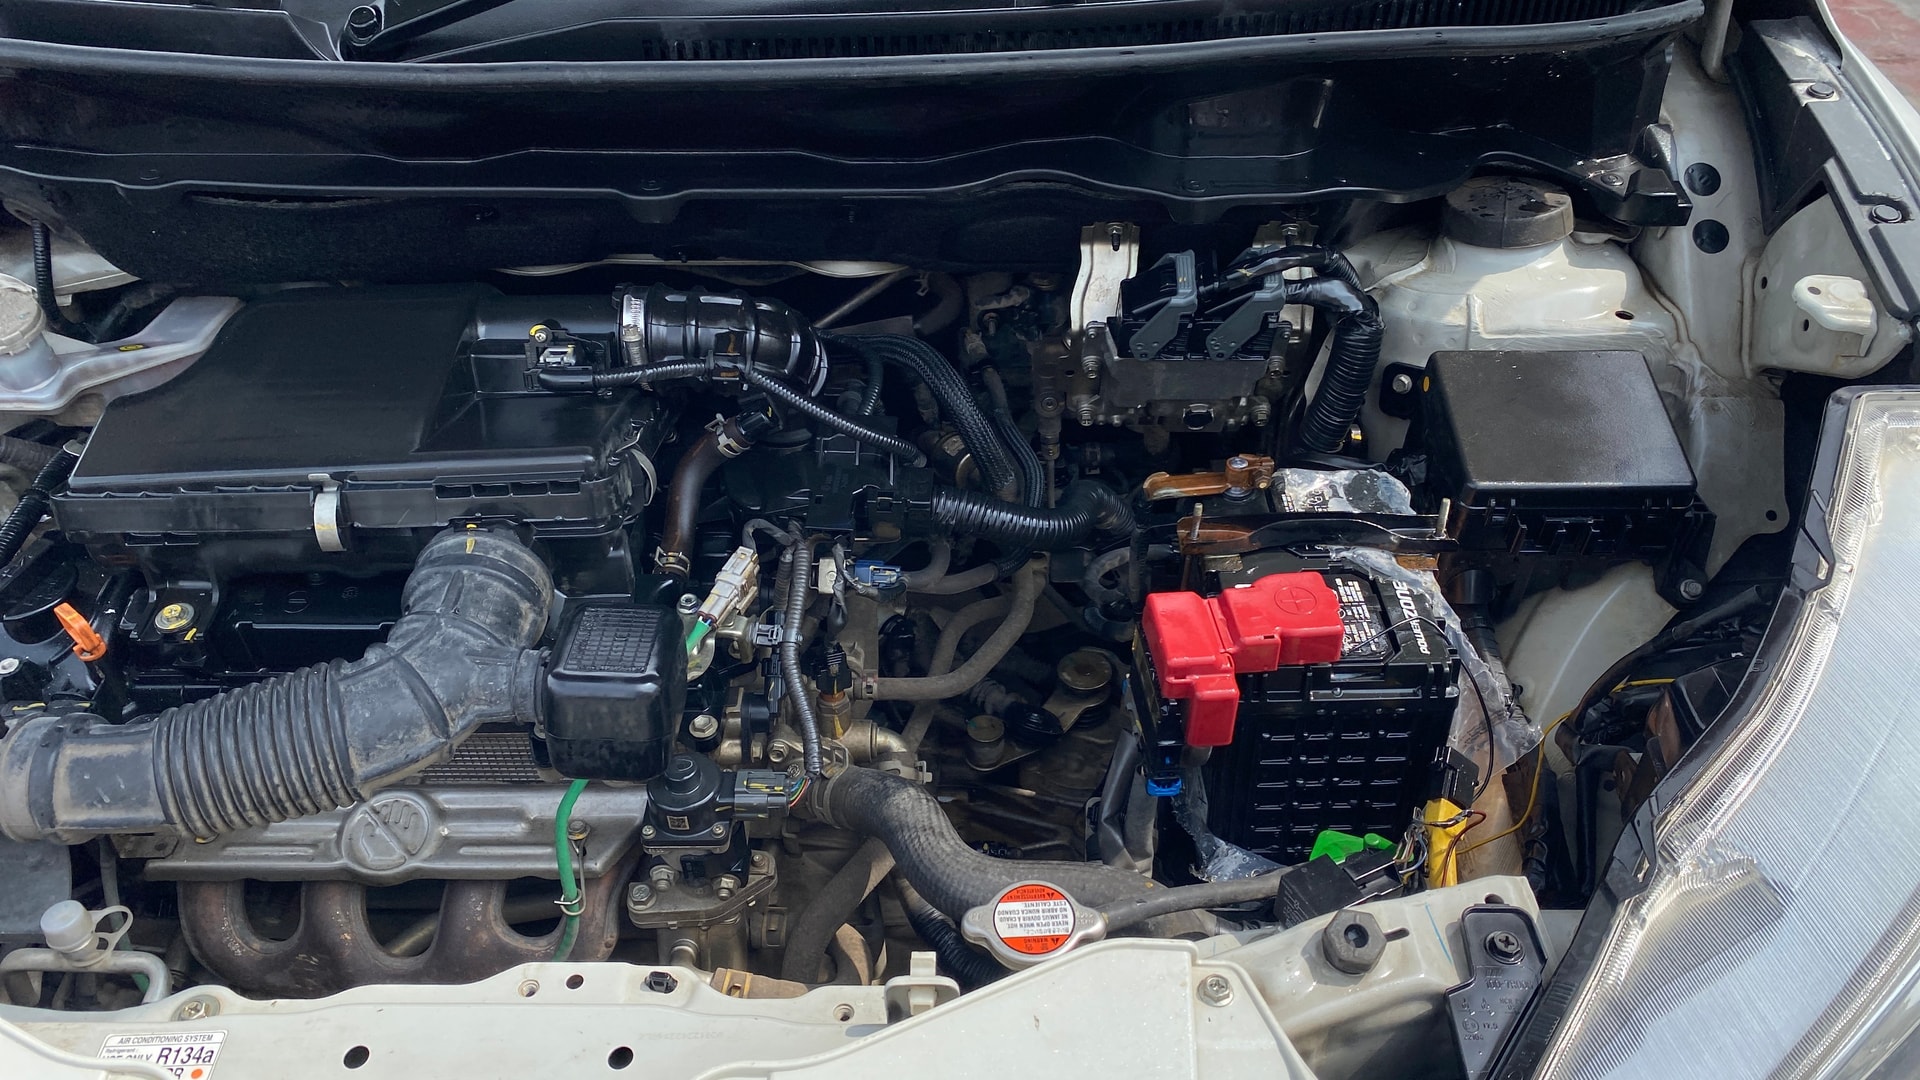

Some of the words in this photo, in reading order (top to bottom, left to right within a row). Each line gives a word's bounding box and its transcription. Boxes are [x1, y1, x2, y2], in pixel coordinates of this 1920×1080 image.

[132, 1035, 183, 1044] CONDITIONING
[184, 1034, 213, 1042] SYSTEM
[156, 1046, 214, 1064] R134a
